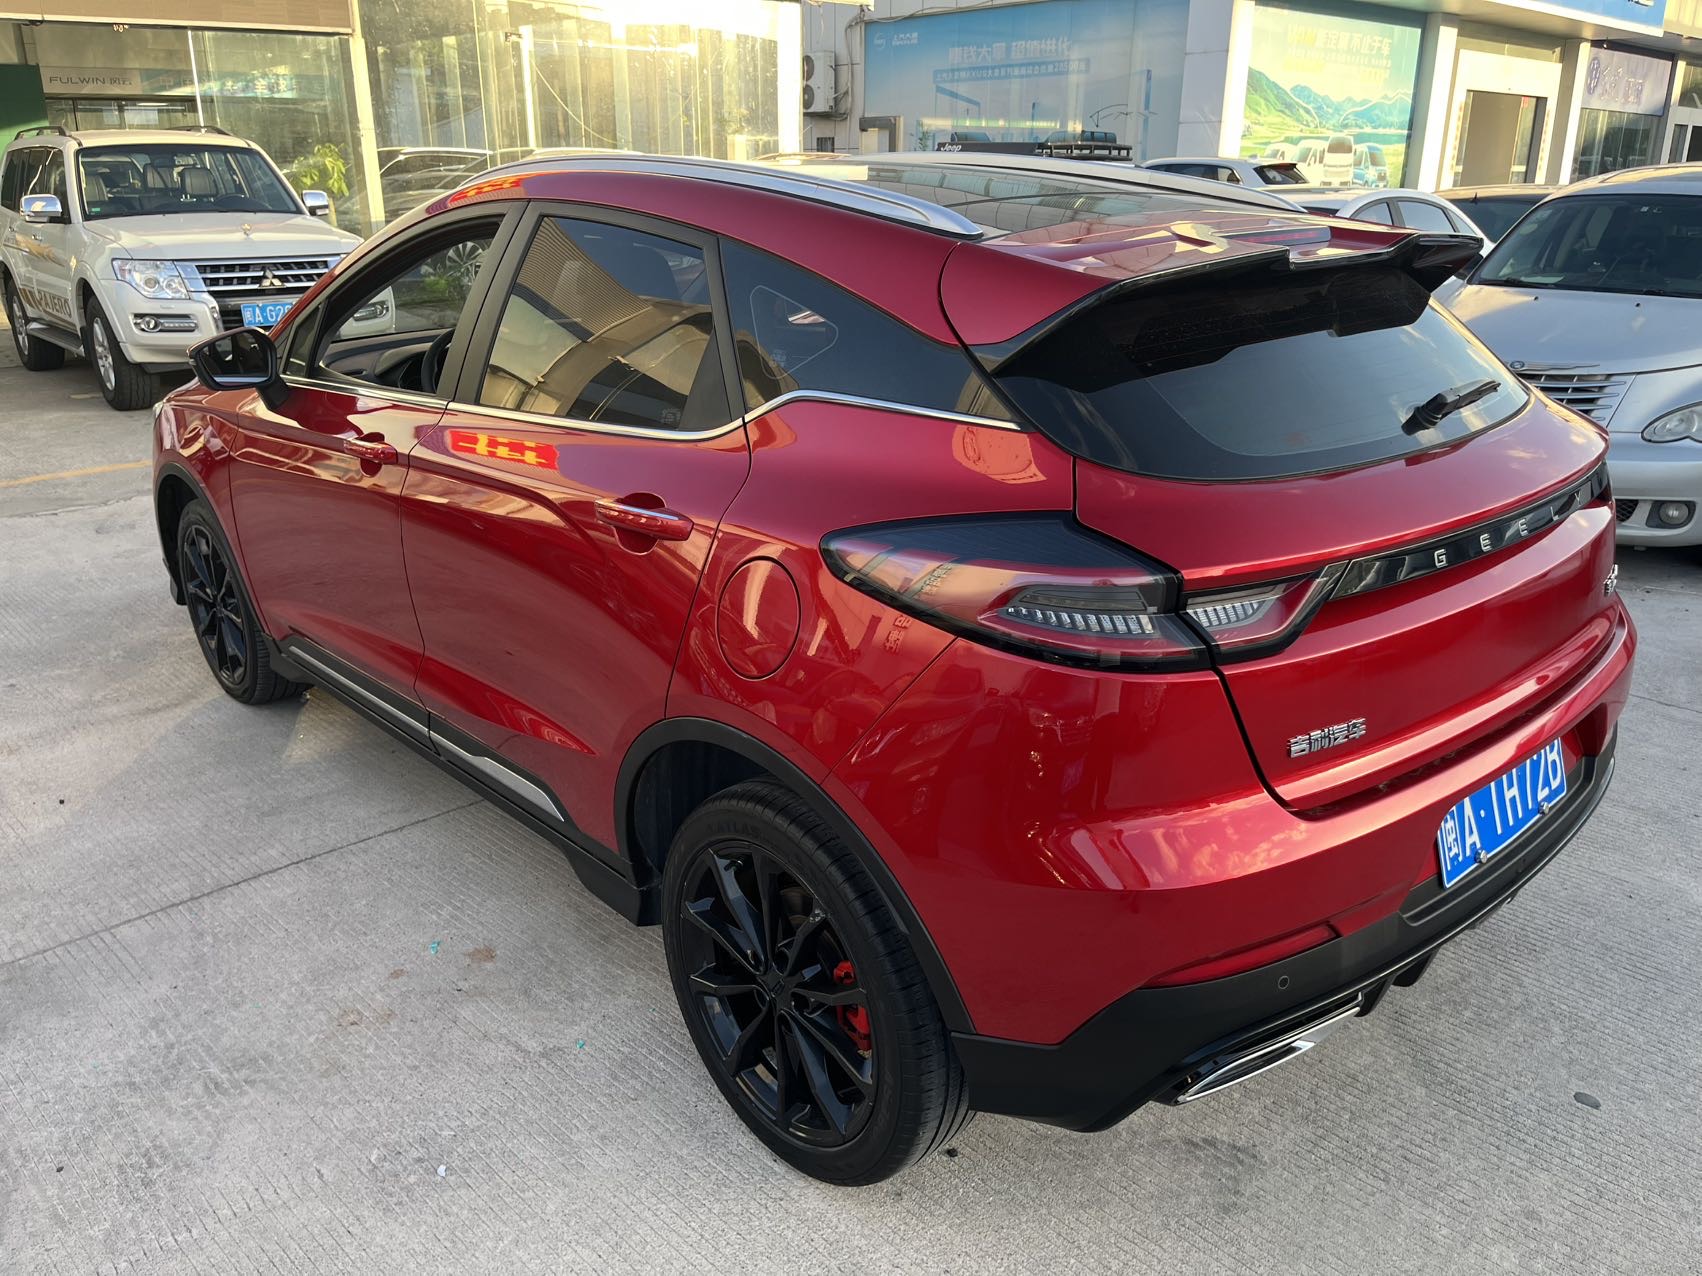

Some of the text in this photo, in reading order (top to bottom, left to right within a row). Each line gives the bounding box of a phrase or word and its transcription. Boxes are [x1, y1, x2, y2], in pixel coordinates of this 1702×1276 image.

[49, 76, 105, 85] FULWIN
[940, 143, 962, 153] Jeep
[37, 290, 72, 318] PAJERO
[1433, 491, 1582, 569] GEELY
[1287, 717, 1367, 758] 吉利汽车
